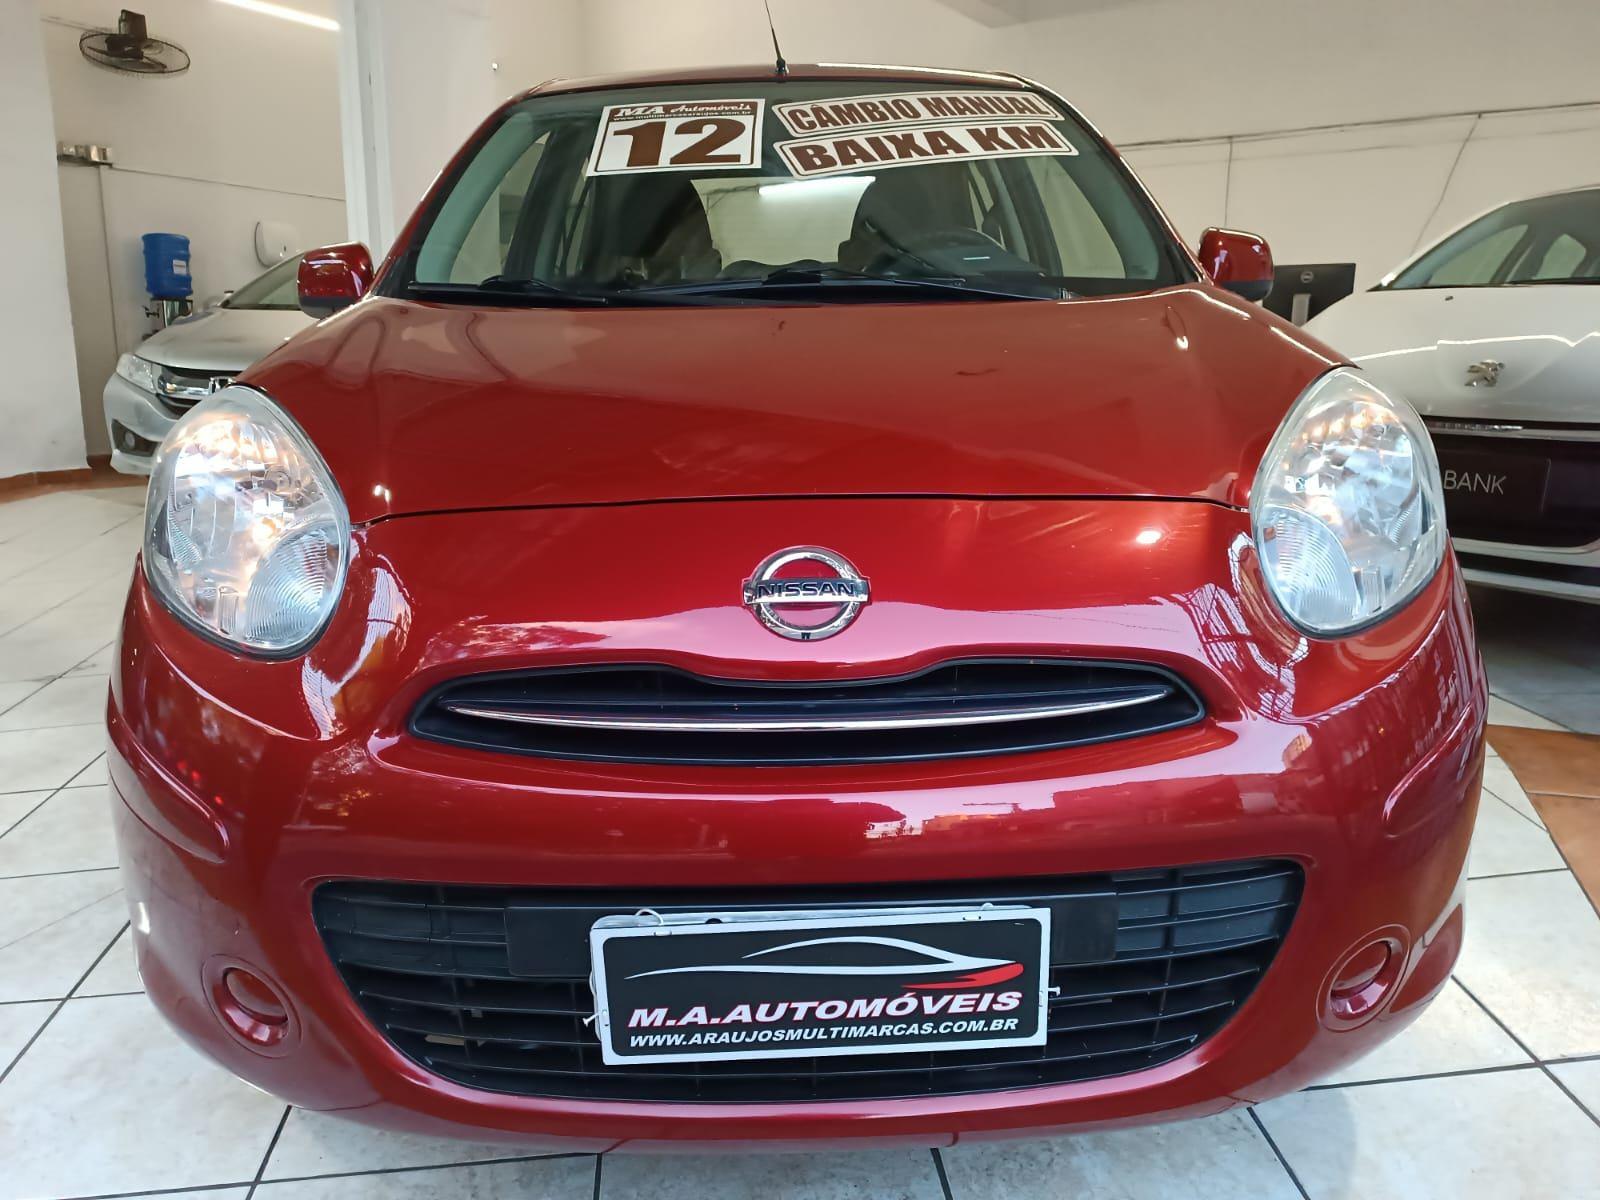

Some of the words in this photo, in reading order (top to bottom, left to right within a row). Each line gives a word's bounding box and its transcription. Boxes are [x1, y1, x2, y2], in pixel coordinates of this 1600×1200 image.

[614, 106, 665, 117] MA
[787, 98, 922, 130] CÂMBIO
[916, 96, 1051, 117] MANUAL
[613, 118, 746, 167] 12
[789, 130, 970, 171] BAIXA
[966, 126, 1063, 151] KM
[1443, 469, 1507, 495] BANK
[758, 582, 856, 598] NISSAN
[628, 991, 1023, 1028] M.A.AUTOMÓVEIS
[630, 1018, 1019, 1047] WWW.ARAUJOSMULTIMARCAS.COM.BR
